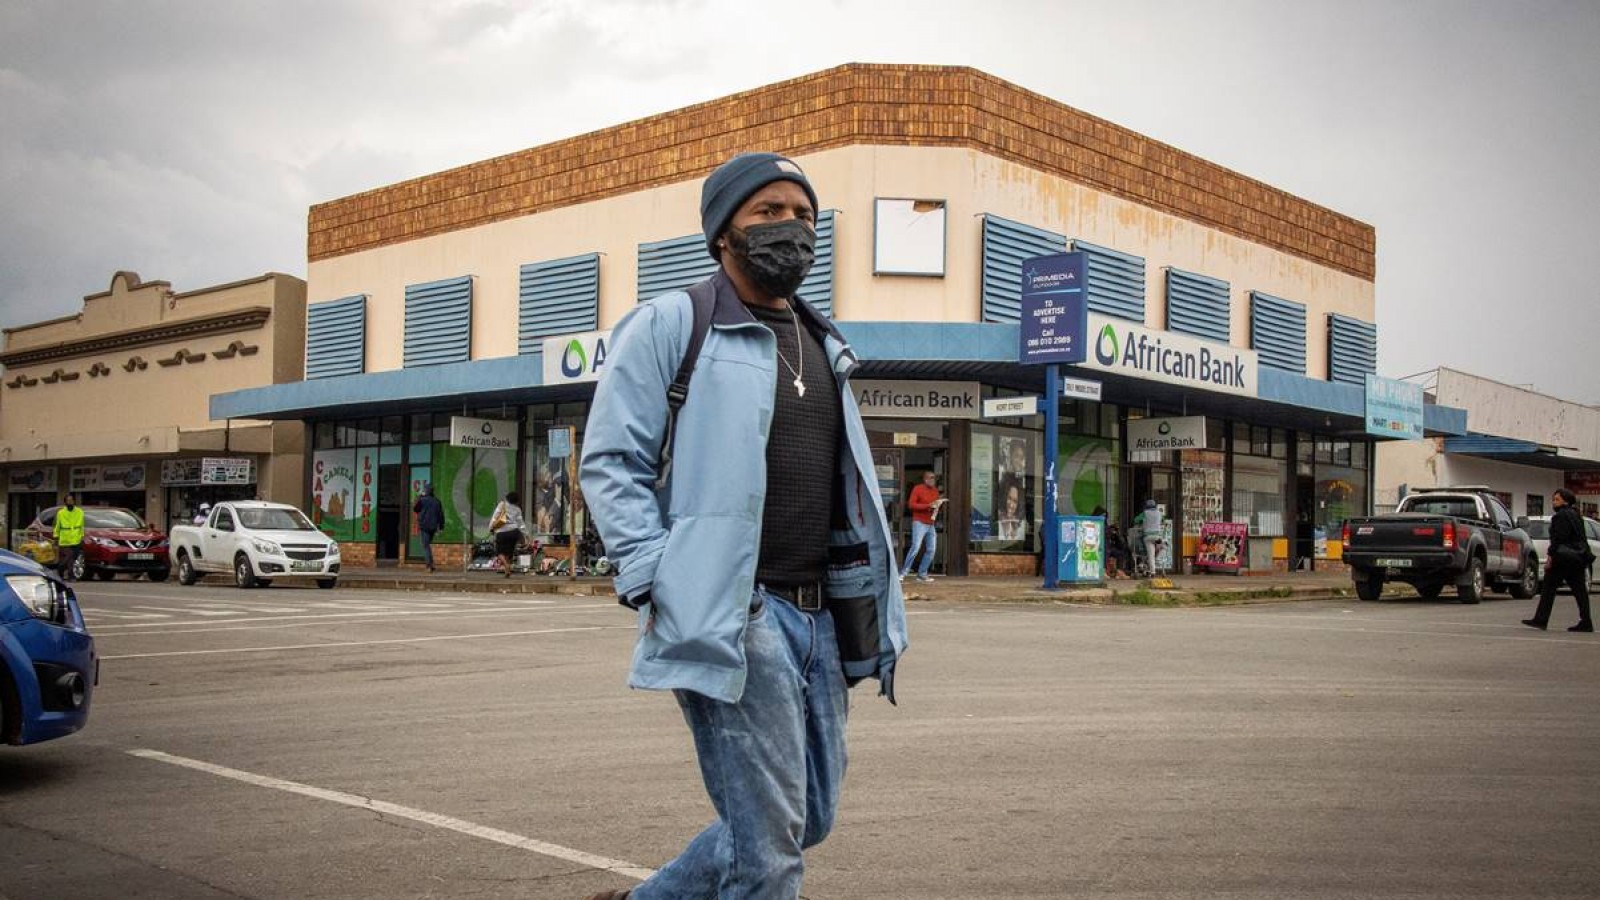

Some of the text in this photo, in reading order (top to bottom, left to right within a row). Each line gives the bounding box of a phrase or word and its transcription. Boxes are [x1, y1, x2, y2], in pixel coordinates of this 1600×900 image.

[1033, 272, 1075, 283] PRIMEDIA
[1033, 306, 1066, 316] ADVERTISE
[1041, 316, 1056, 324] HERE
[1042, 329, 1055, 337] Call
[1122, 332, 1245, 388] African Bank
[860, 389, 974, 408] African Bank
[461, 434, 511, 448] African Bank
[1136, 437, 1195, 449] African Bank
[361, 455, 372, 534] LOANS
